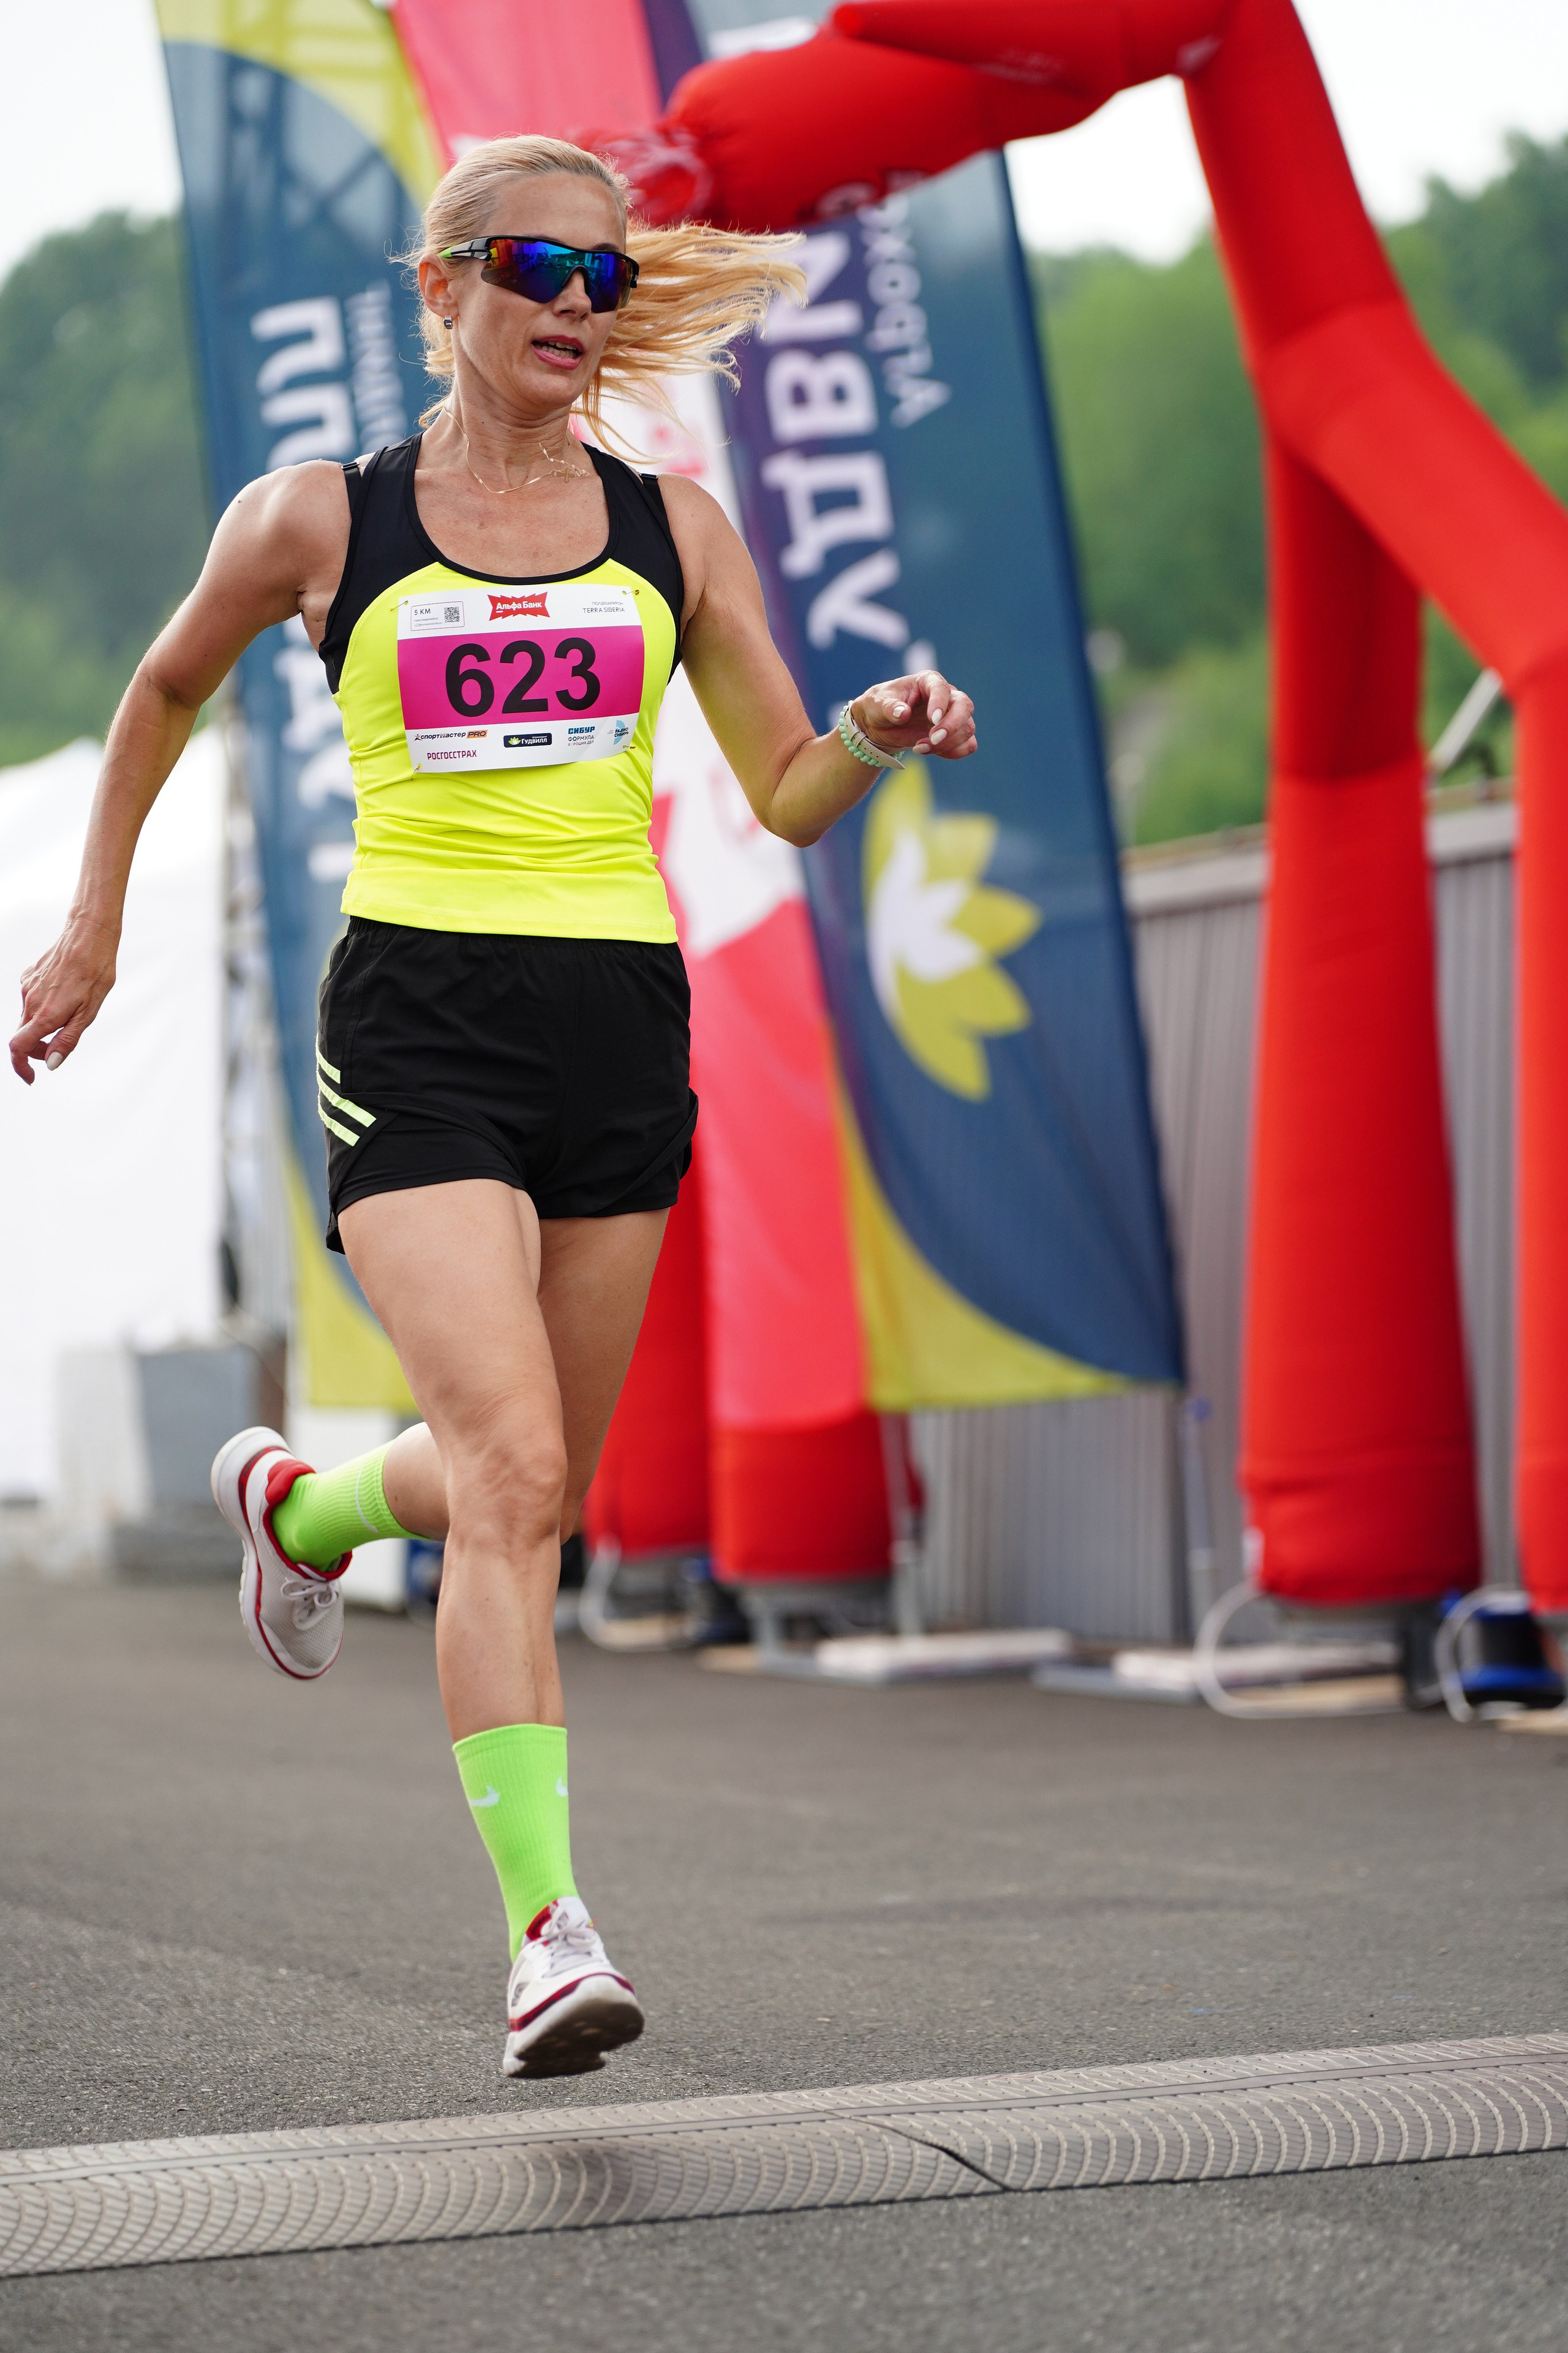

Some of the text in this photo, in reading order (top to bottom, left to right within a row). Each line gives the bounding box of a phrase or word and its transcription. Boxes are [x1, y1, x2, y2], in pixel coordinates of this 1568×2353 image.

[496, 602, 521, 611] Альфа
[445, 637, 601, 717] 623
[568, 726, 595, 735] СИБУР
[427, 750, 477, 760] РОСГОССТРАХ
